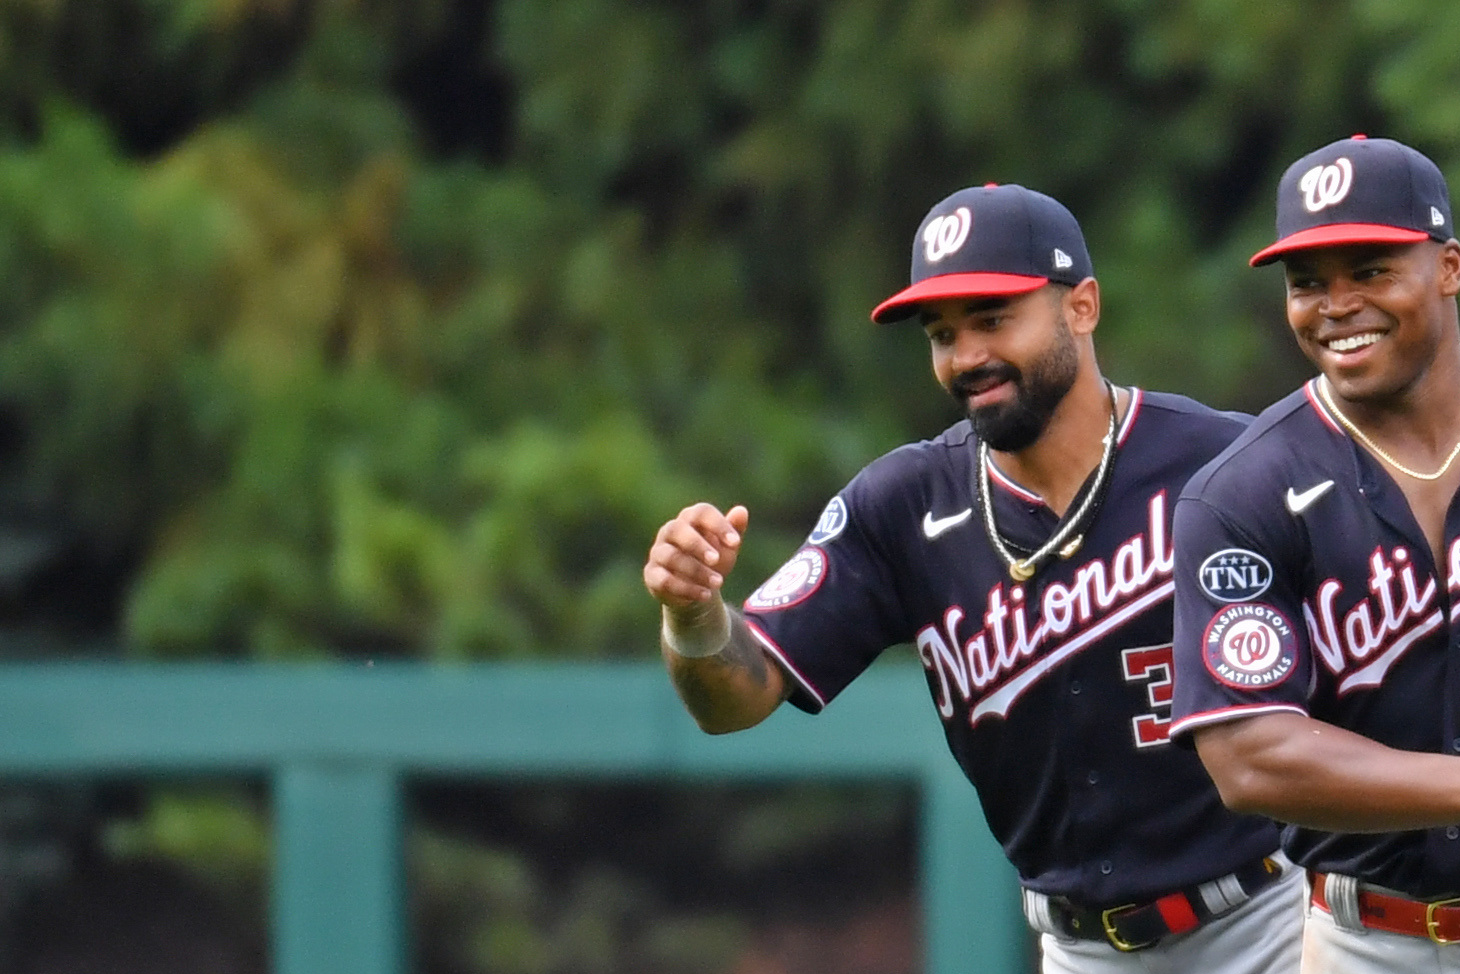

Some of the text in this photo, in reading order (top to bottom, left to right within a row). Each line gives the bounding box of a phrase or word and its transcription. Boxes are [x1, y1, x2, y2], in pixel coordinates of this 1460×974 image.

[1300, 157, 1353, 213] W
[923, 207, 972, 263] W
[916, 487, 1175, 719] National
[1204, 564, 1268, 591] TNL
[1207, 604, 1291, 644] WASHINGTON
[1120, 642, 1176, 749] 3
[1216, 656, 1292, 686] NATIONALS
